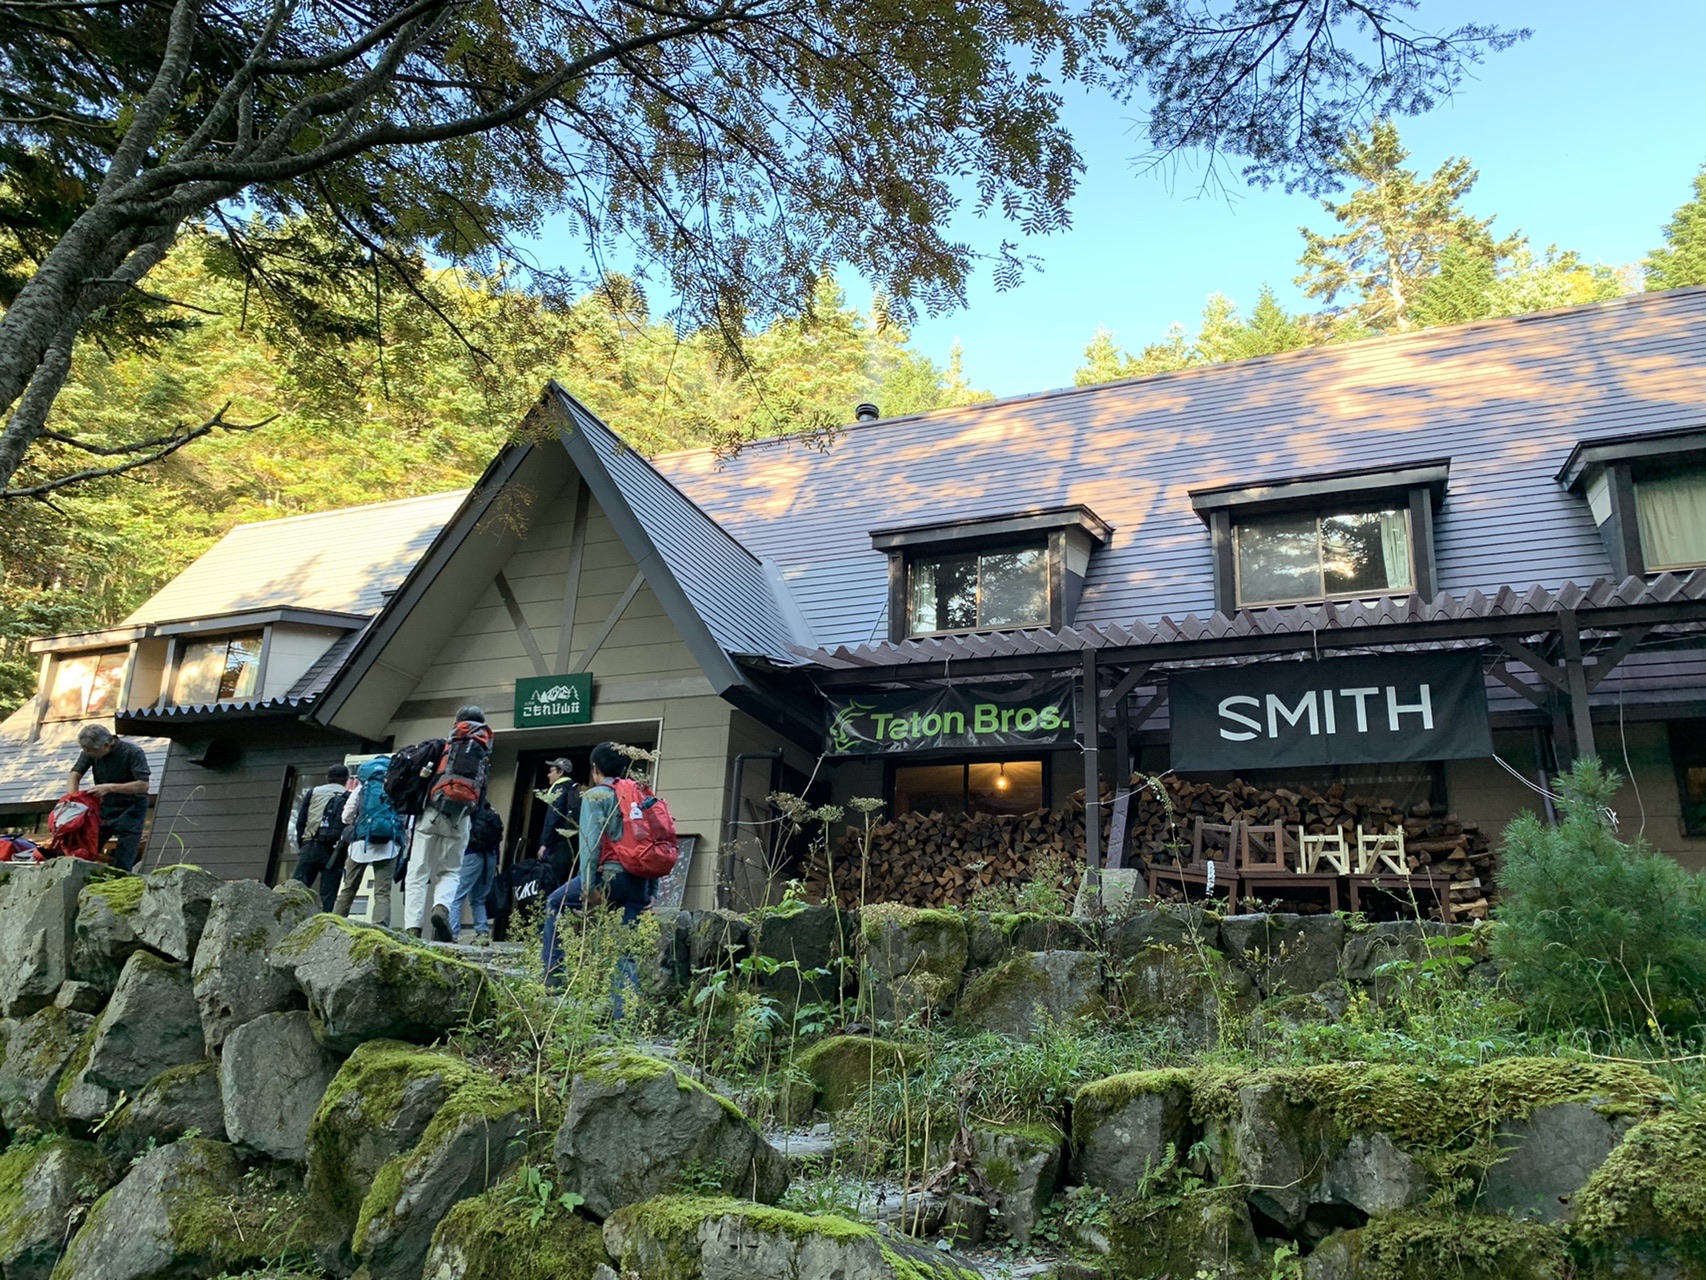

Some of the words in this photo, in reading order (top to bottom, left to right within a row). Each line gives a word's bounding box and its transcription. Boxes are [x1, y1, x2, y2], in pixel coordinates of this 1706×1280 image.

[523, 701, 580, 717] こもれび山荘
[870, 710, 964, 740] Teton
[974, 703, 1070, 734] Bros.
[1218, 684, 1434, 741] SMITH
